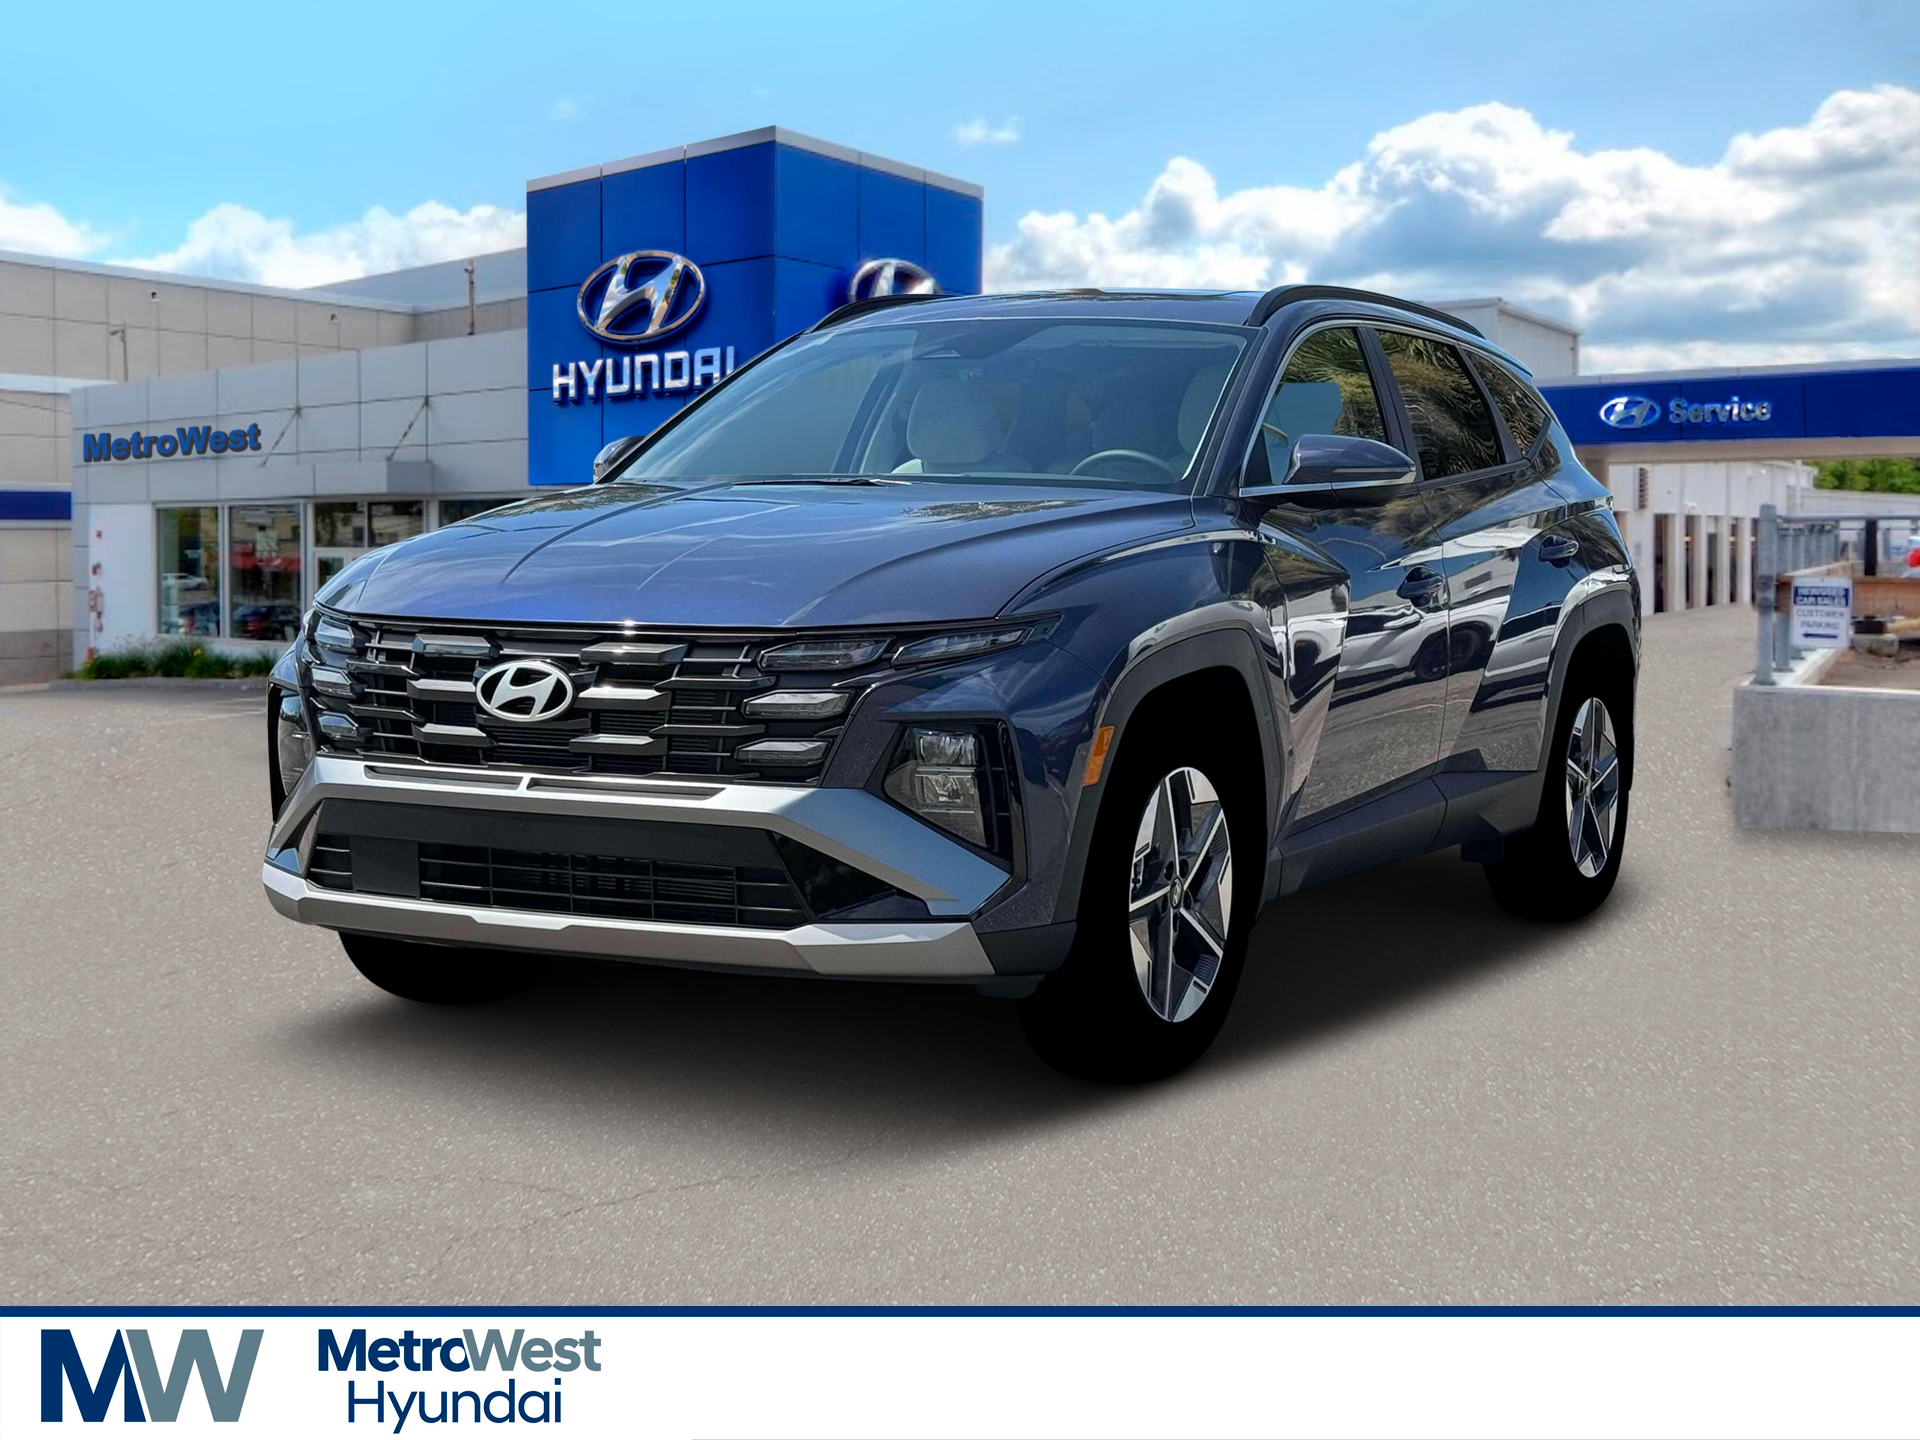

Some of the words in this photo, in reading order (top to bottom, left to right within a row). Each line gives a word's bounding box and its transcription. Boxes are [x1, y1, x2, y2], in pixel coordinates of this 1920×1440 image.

[552, 345, 735, 401] HYUNDAI
[1669, 396, 1772, 424] Service
[83, 423, 262, 462] MetroWest
[1796, 609, 1844, 618] CUSTOMER
[1800, 620, 1840, 629] PARKING
